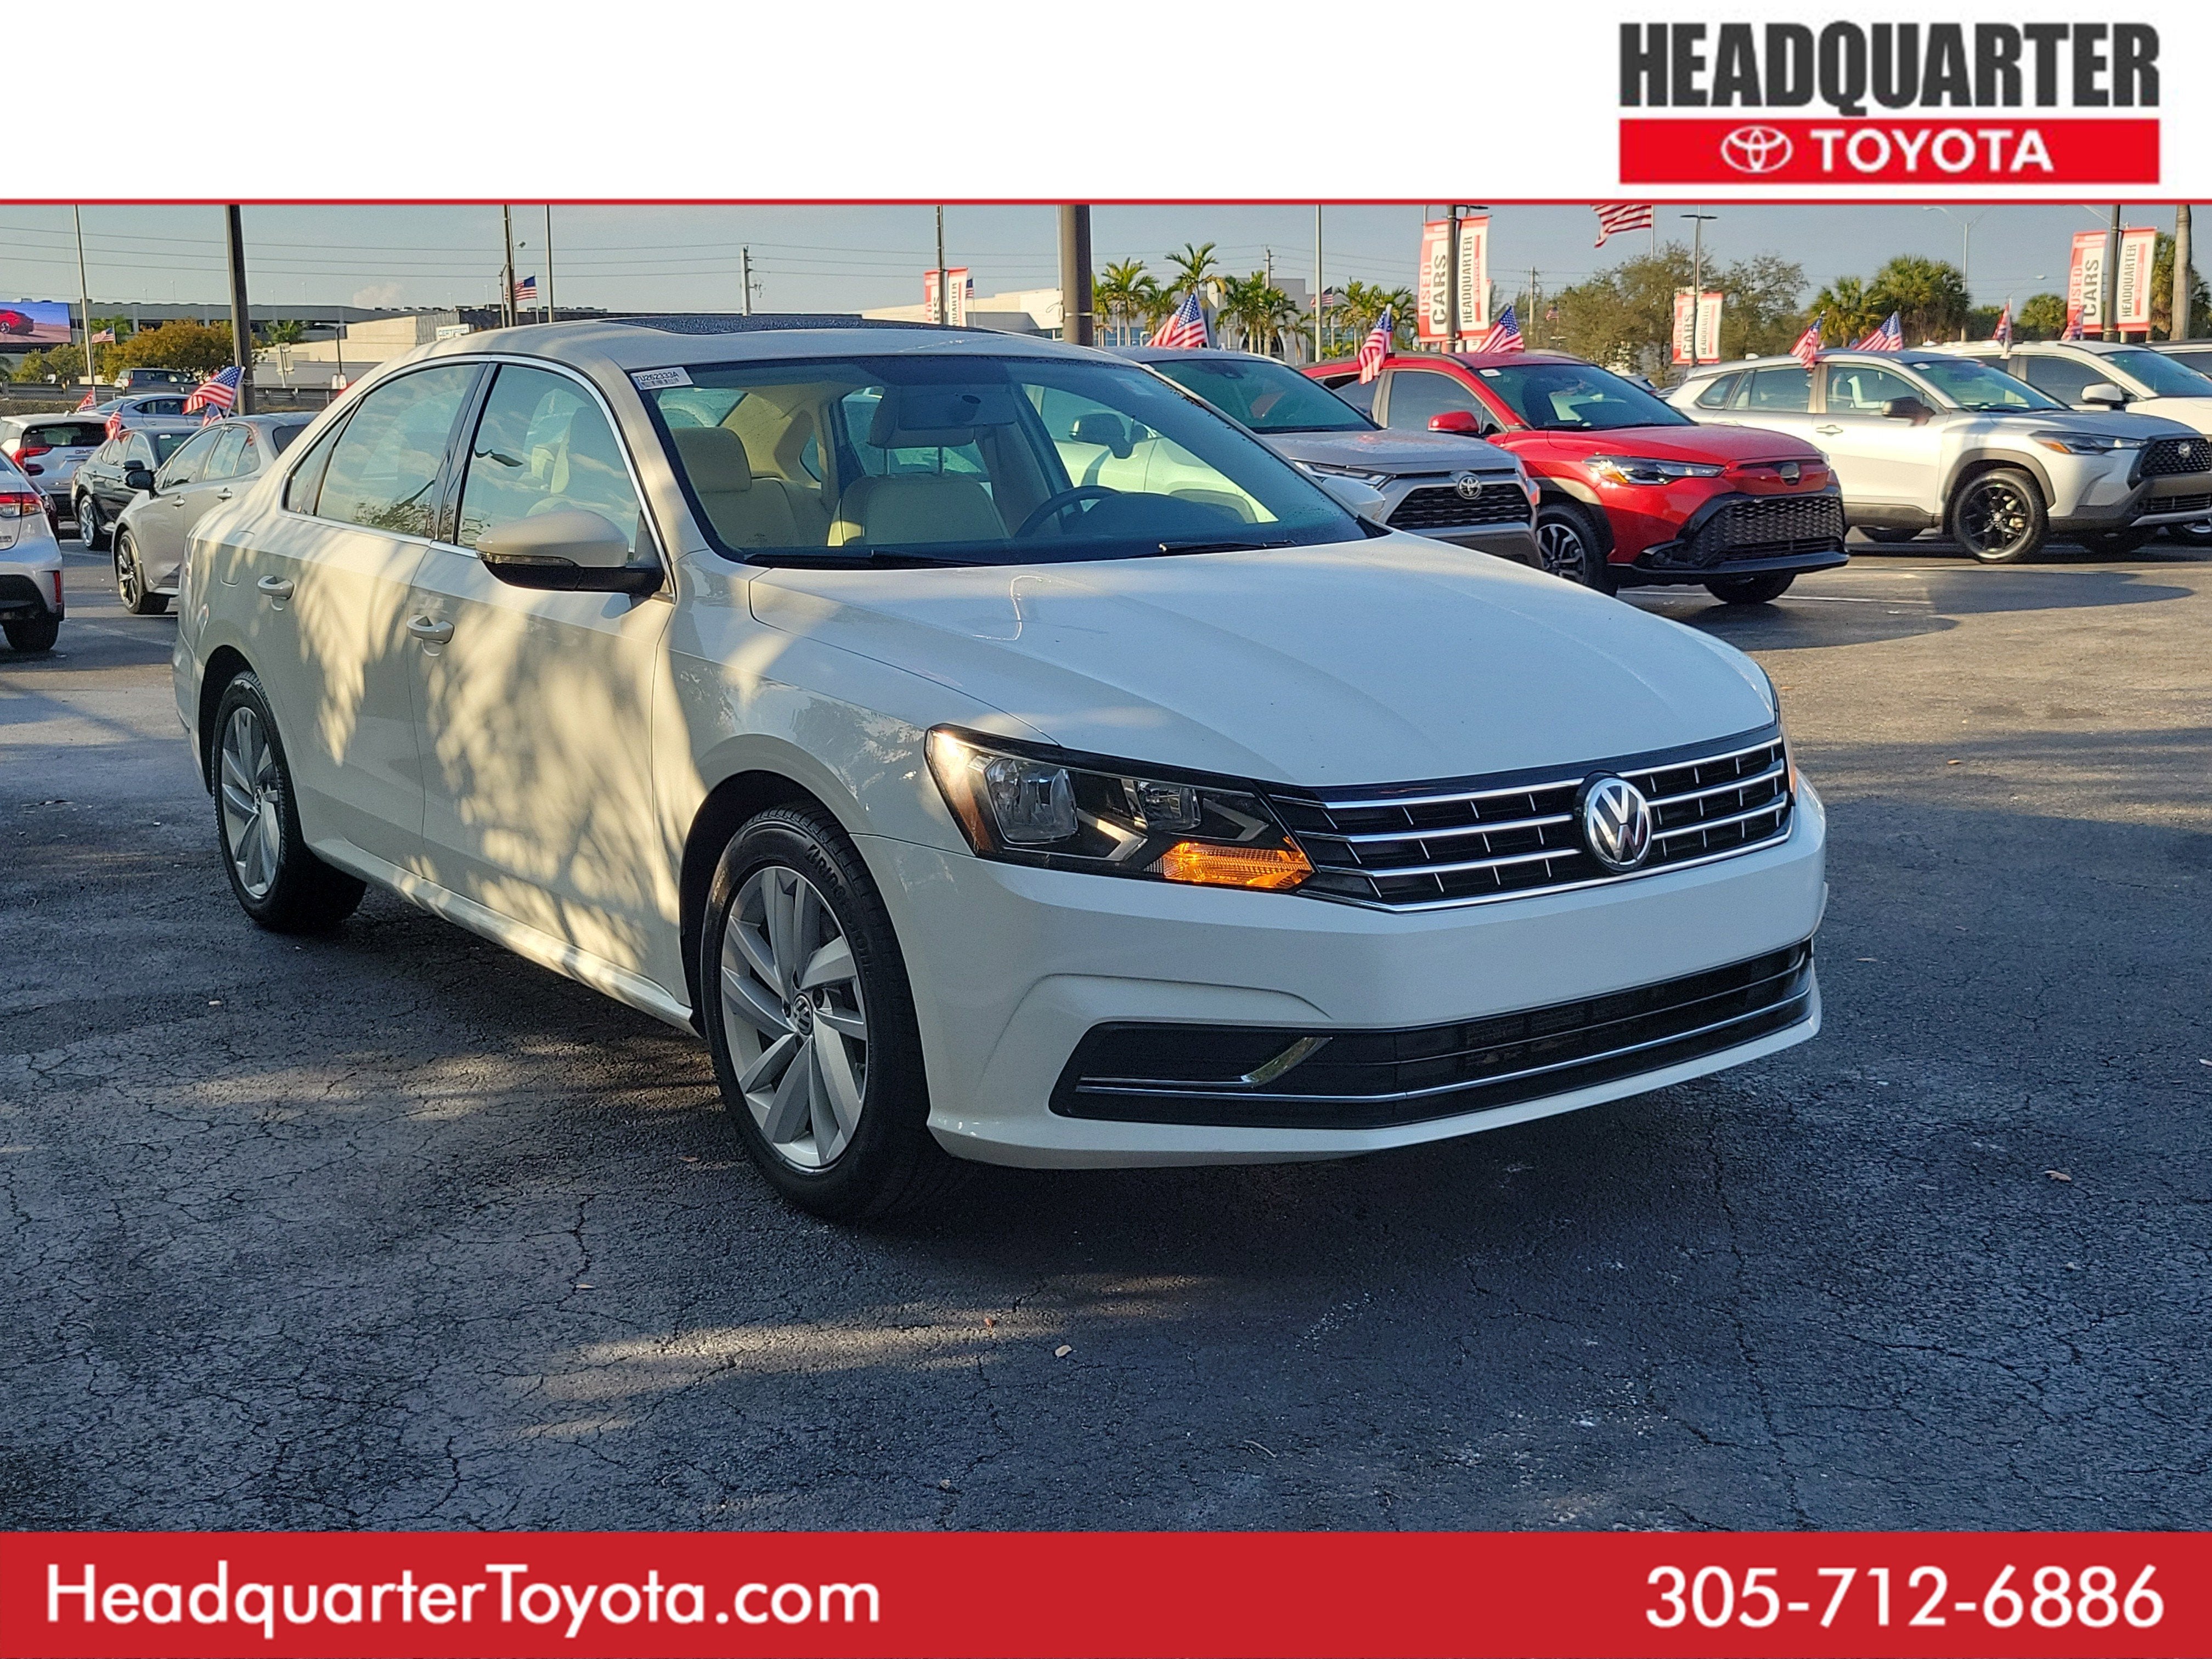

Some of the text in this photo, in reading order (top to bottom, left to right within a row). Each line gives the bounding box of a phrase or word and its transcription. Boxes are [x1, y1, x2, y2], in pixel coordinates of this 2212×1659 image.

[1421, 264, 1431, 313] USED
[1432, 254, 1446, 324] CARS
[1463, 236, 1473, 323] HEADQUARTER
[2070, 267, 2083, 309] USED
[2083, 259, 2099, 317] CARS
[2121, 244, 2137, 317] HEADQUARTER
